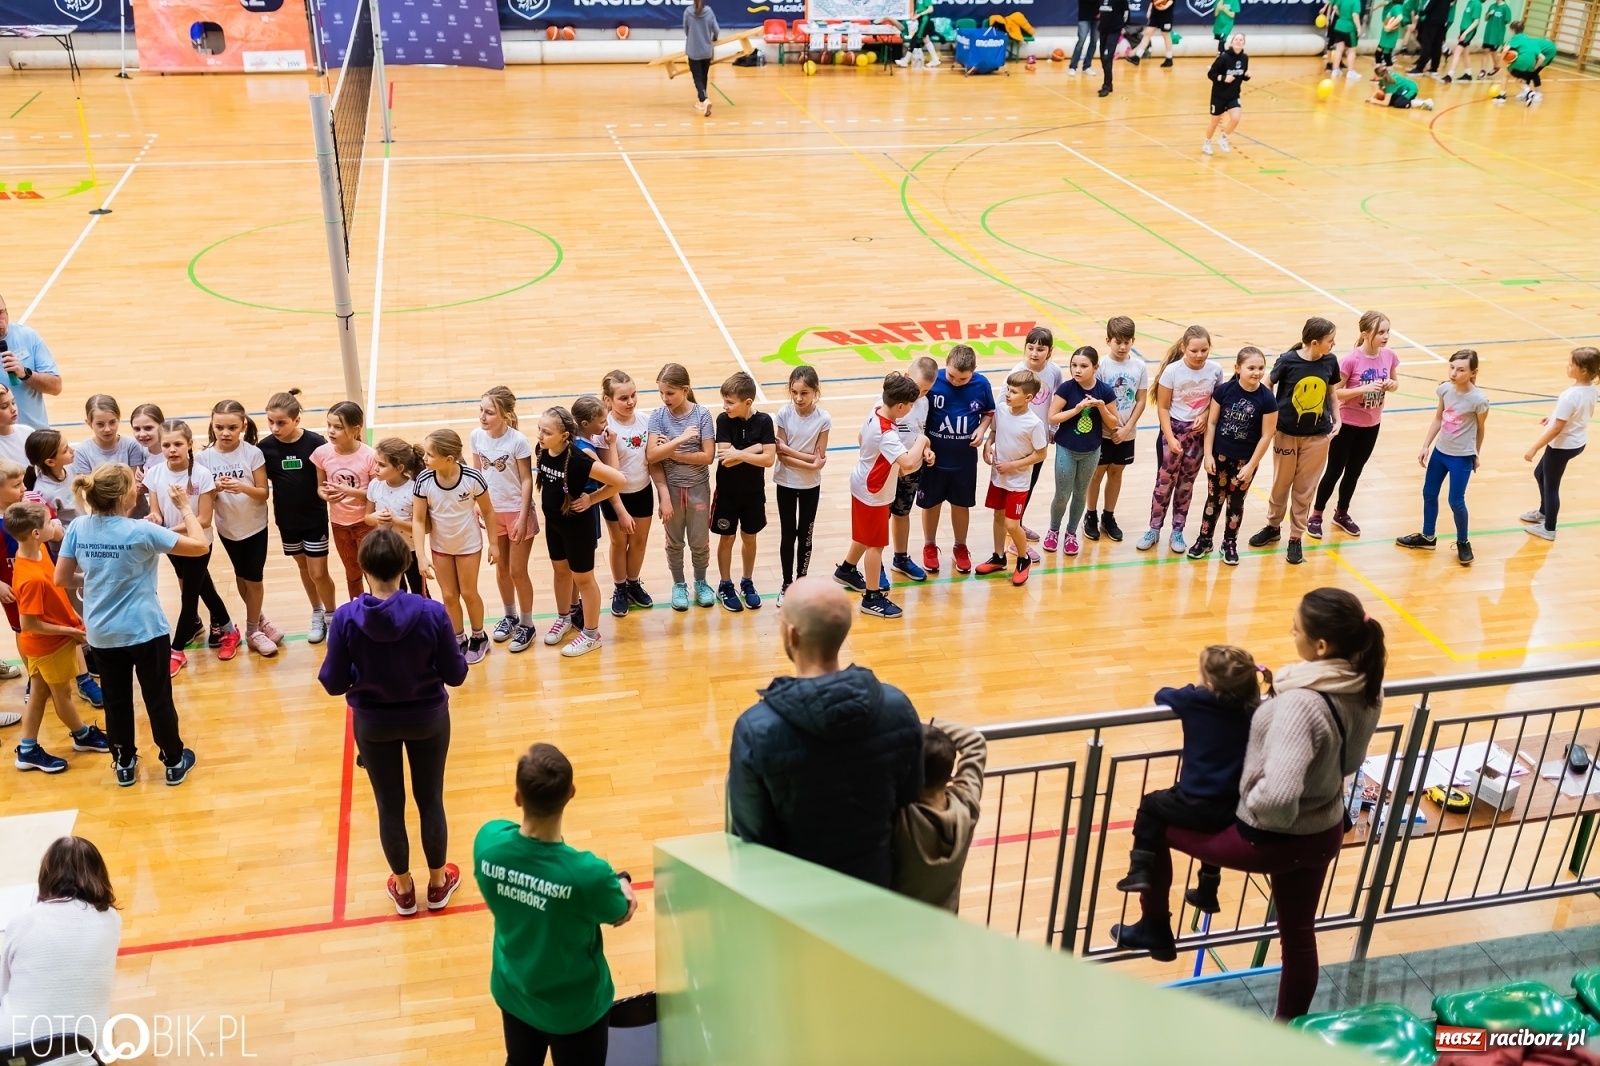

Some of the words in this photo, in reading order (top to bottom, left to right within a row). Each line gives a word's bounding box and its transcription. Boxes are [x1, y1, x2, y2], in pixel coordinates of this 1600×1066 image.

[773, 3, 804, 12] RACIBÓ
[933, 394, 945, 409] 10
[1273, 446, 1296, 456] NASA
[481, 859, 506, 881] KLUB
[507, 869, 572, 900] SIATKARSKI
[496, 882, 547, 912] RACIBÓRZ
